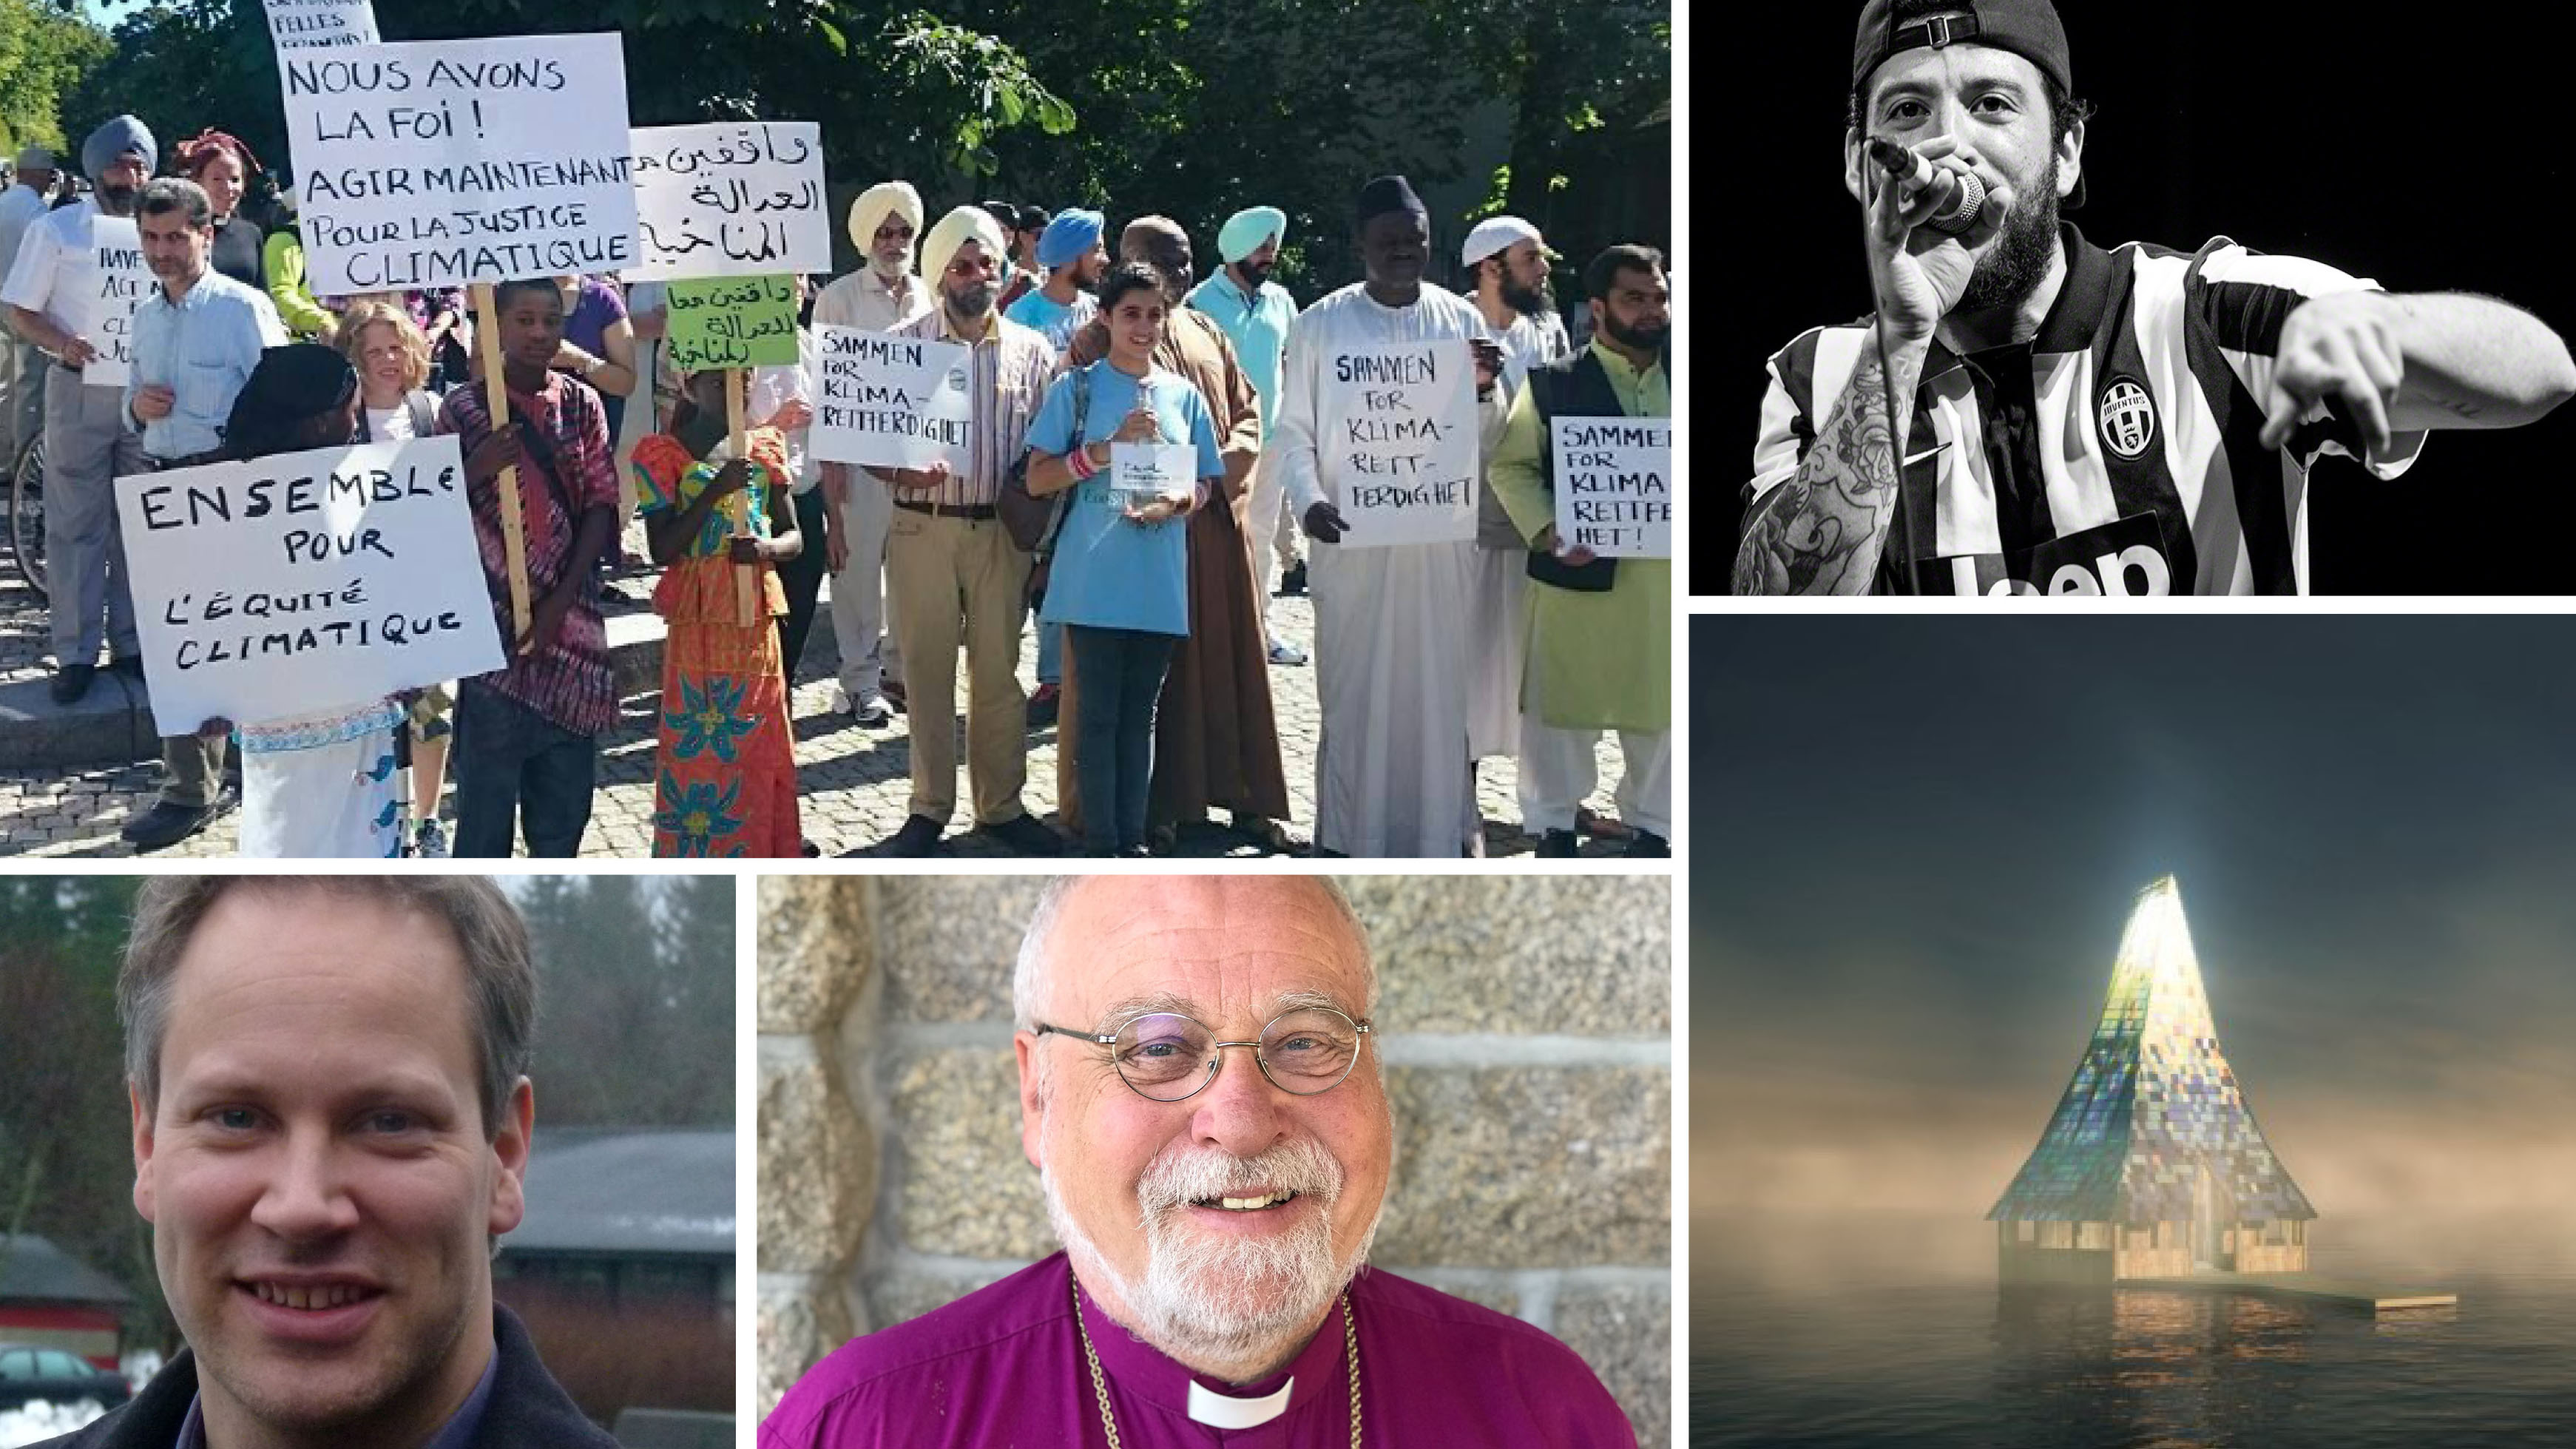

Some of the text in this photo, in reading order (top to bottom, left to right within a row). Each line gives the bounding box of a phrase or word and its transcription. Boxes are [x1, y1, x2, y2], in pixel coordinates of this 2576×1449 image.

[288, 58, 566, 95] NOUS AVONS
[317, 109, 374, 141] LA
[307, 169, 414, 202] AGIR
[424, 156, 634, 193] MAINTENANT
[307, 203, 587, 246] POUR LA JUSTICE
[346, 234, 629, 286] CLIMATIQUE
[822, 330, 922, 368] SAMMEN
[1336, 348, 1436, 385] SAMMEN
[822, 359, 863, 382] FOR
[1362, 389, 1411, 410] FOR
[2103, 396, 2146, 416] JUVENTUS
[1566, 450, 1619, 470] FOR
[141, 465, 455, 530] ENSEMBLE
[1351, 476, 1473, 508] FERDIGHET
[1569, 472, 1665, 496] KLIMA
[283, 529, 394, 564] POUR
[176, 612, 462, 669] CLIMATIQUE
